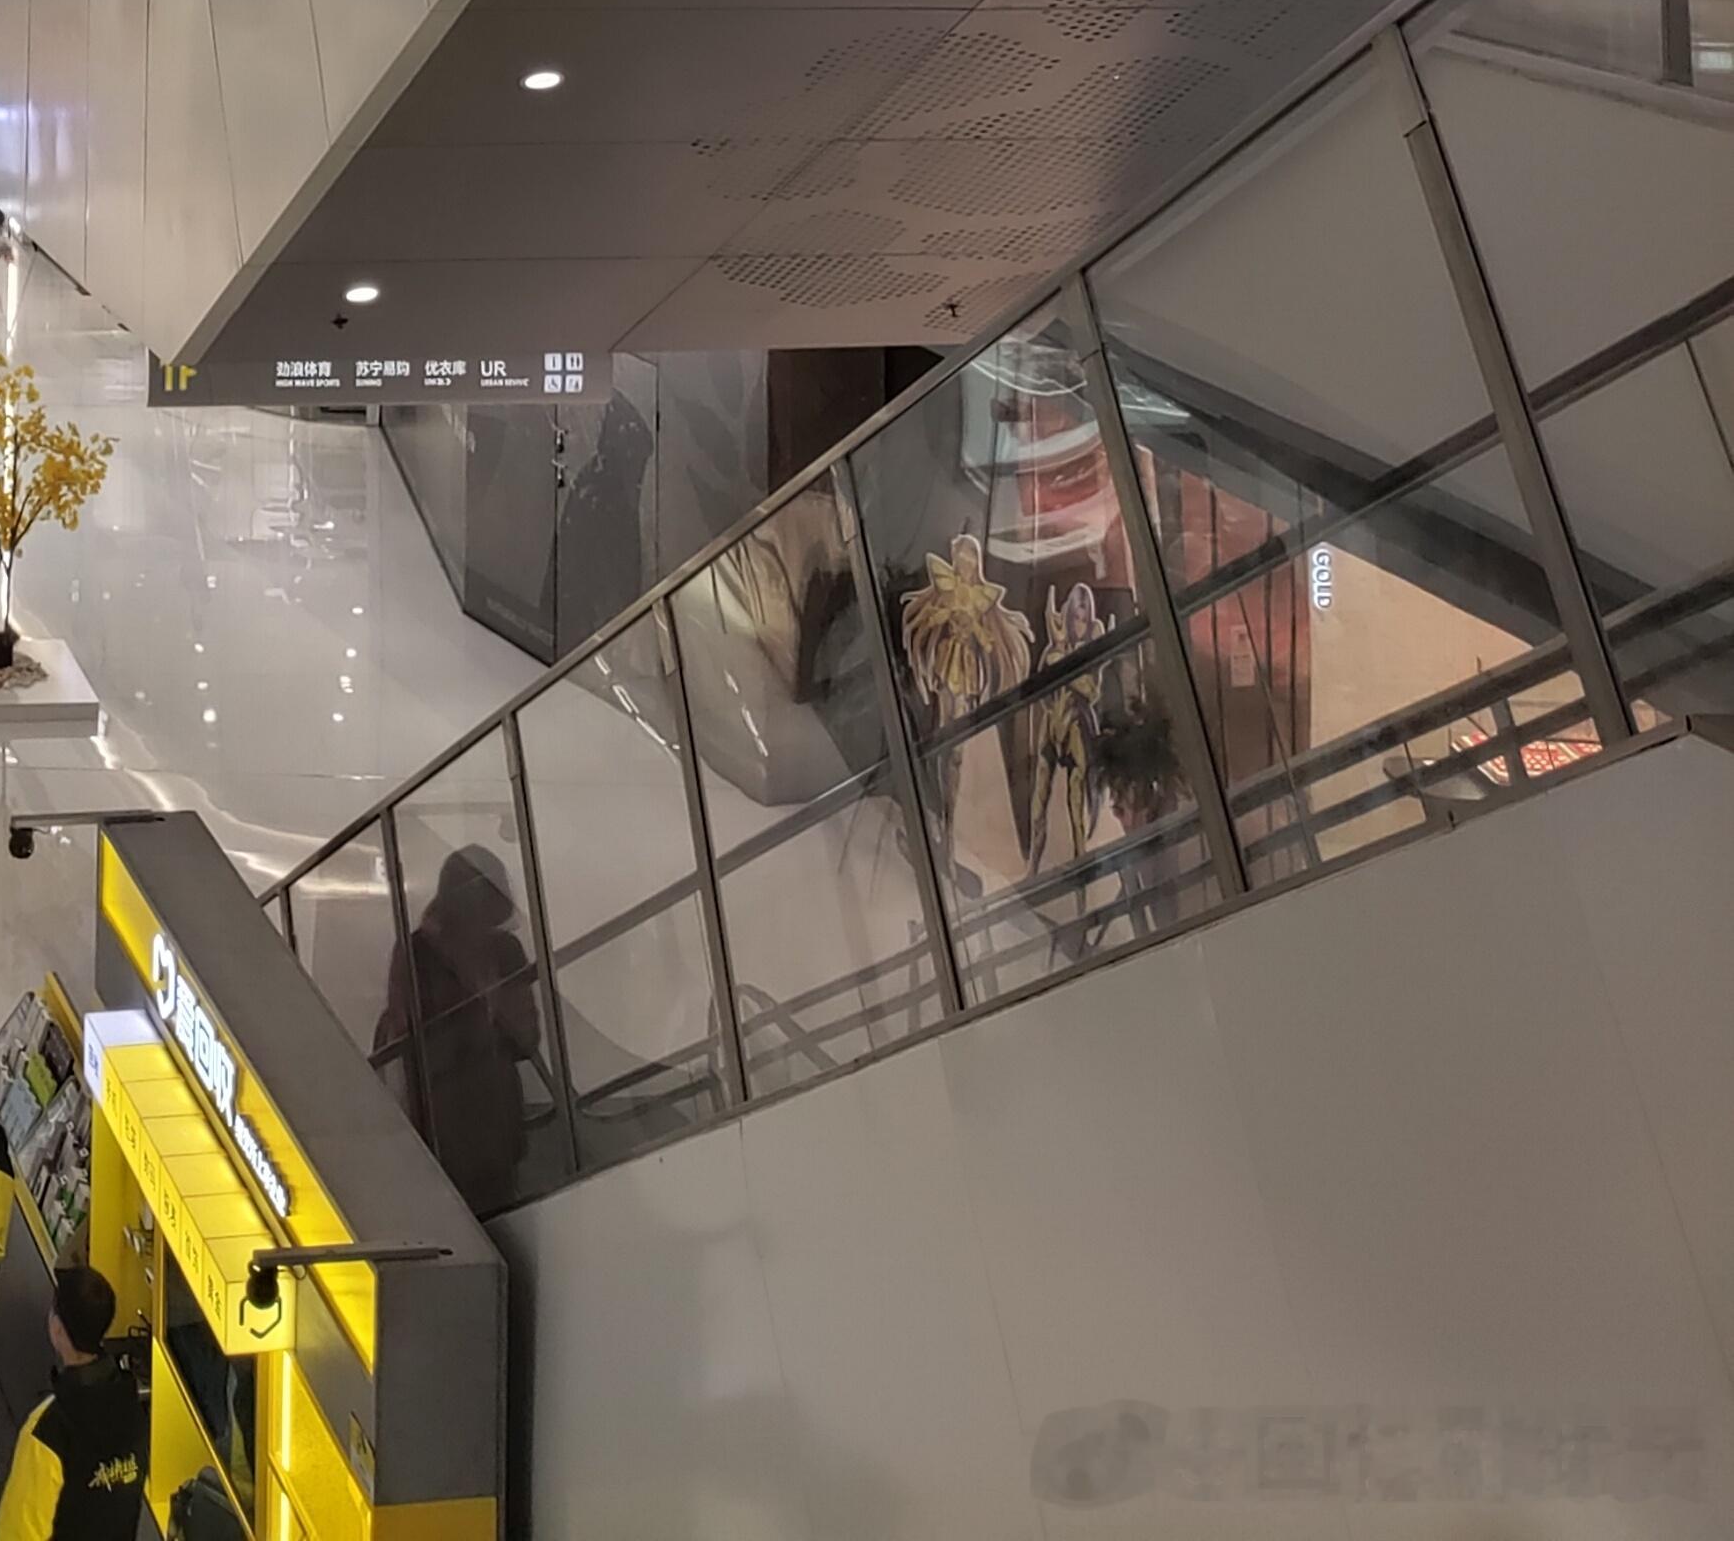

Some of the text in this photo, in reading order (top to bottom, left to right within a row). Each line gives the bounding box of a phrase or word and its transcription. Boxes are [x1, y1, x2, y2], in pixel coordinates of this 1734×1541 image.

[276, 360, 507, 377] 劲浪体育 苏宁易购 优衣库 UR
[1312, 549, 1332, 609] GOLD
